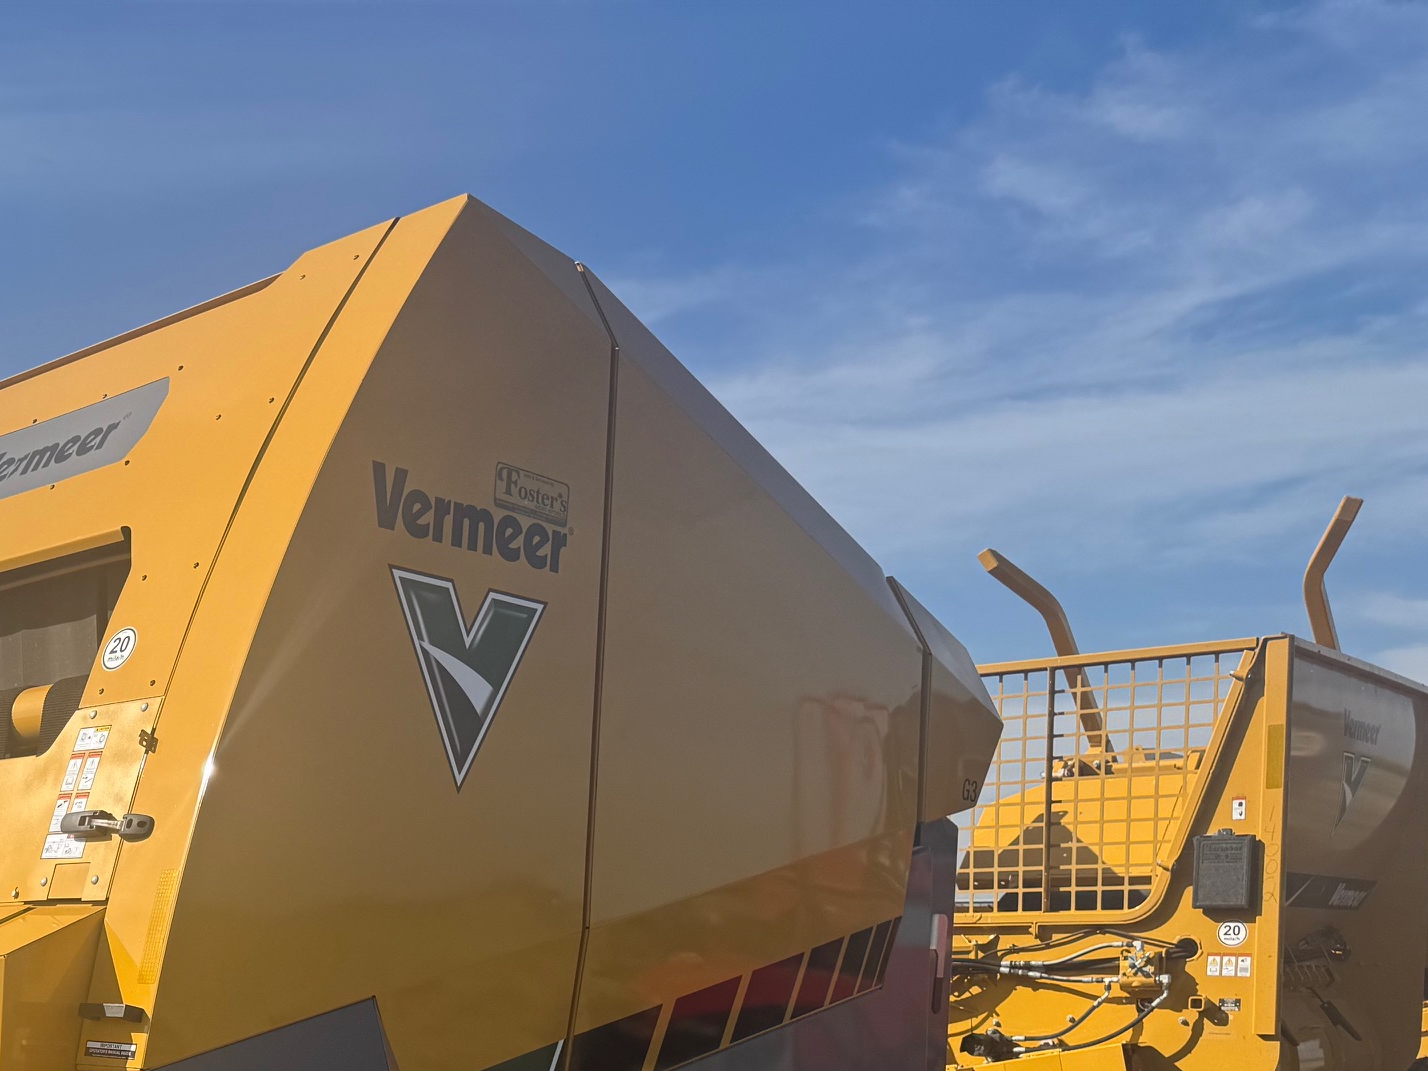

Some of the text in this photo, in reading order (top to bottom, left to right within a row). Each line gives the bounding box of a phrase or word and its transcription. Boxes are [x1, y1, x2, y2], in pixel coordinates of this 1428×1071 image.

[497, 465, 568, 513] Foster's
[372, 459, 568, 574] Vermeer
[108, 635, 131, 655] 20
[1343, 708, 1382, 746] Vermeer
[962, 778, 978, 802] G3
[1223, 924, 1241, 936] 20
